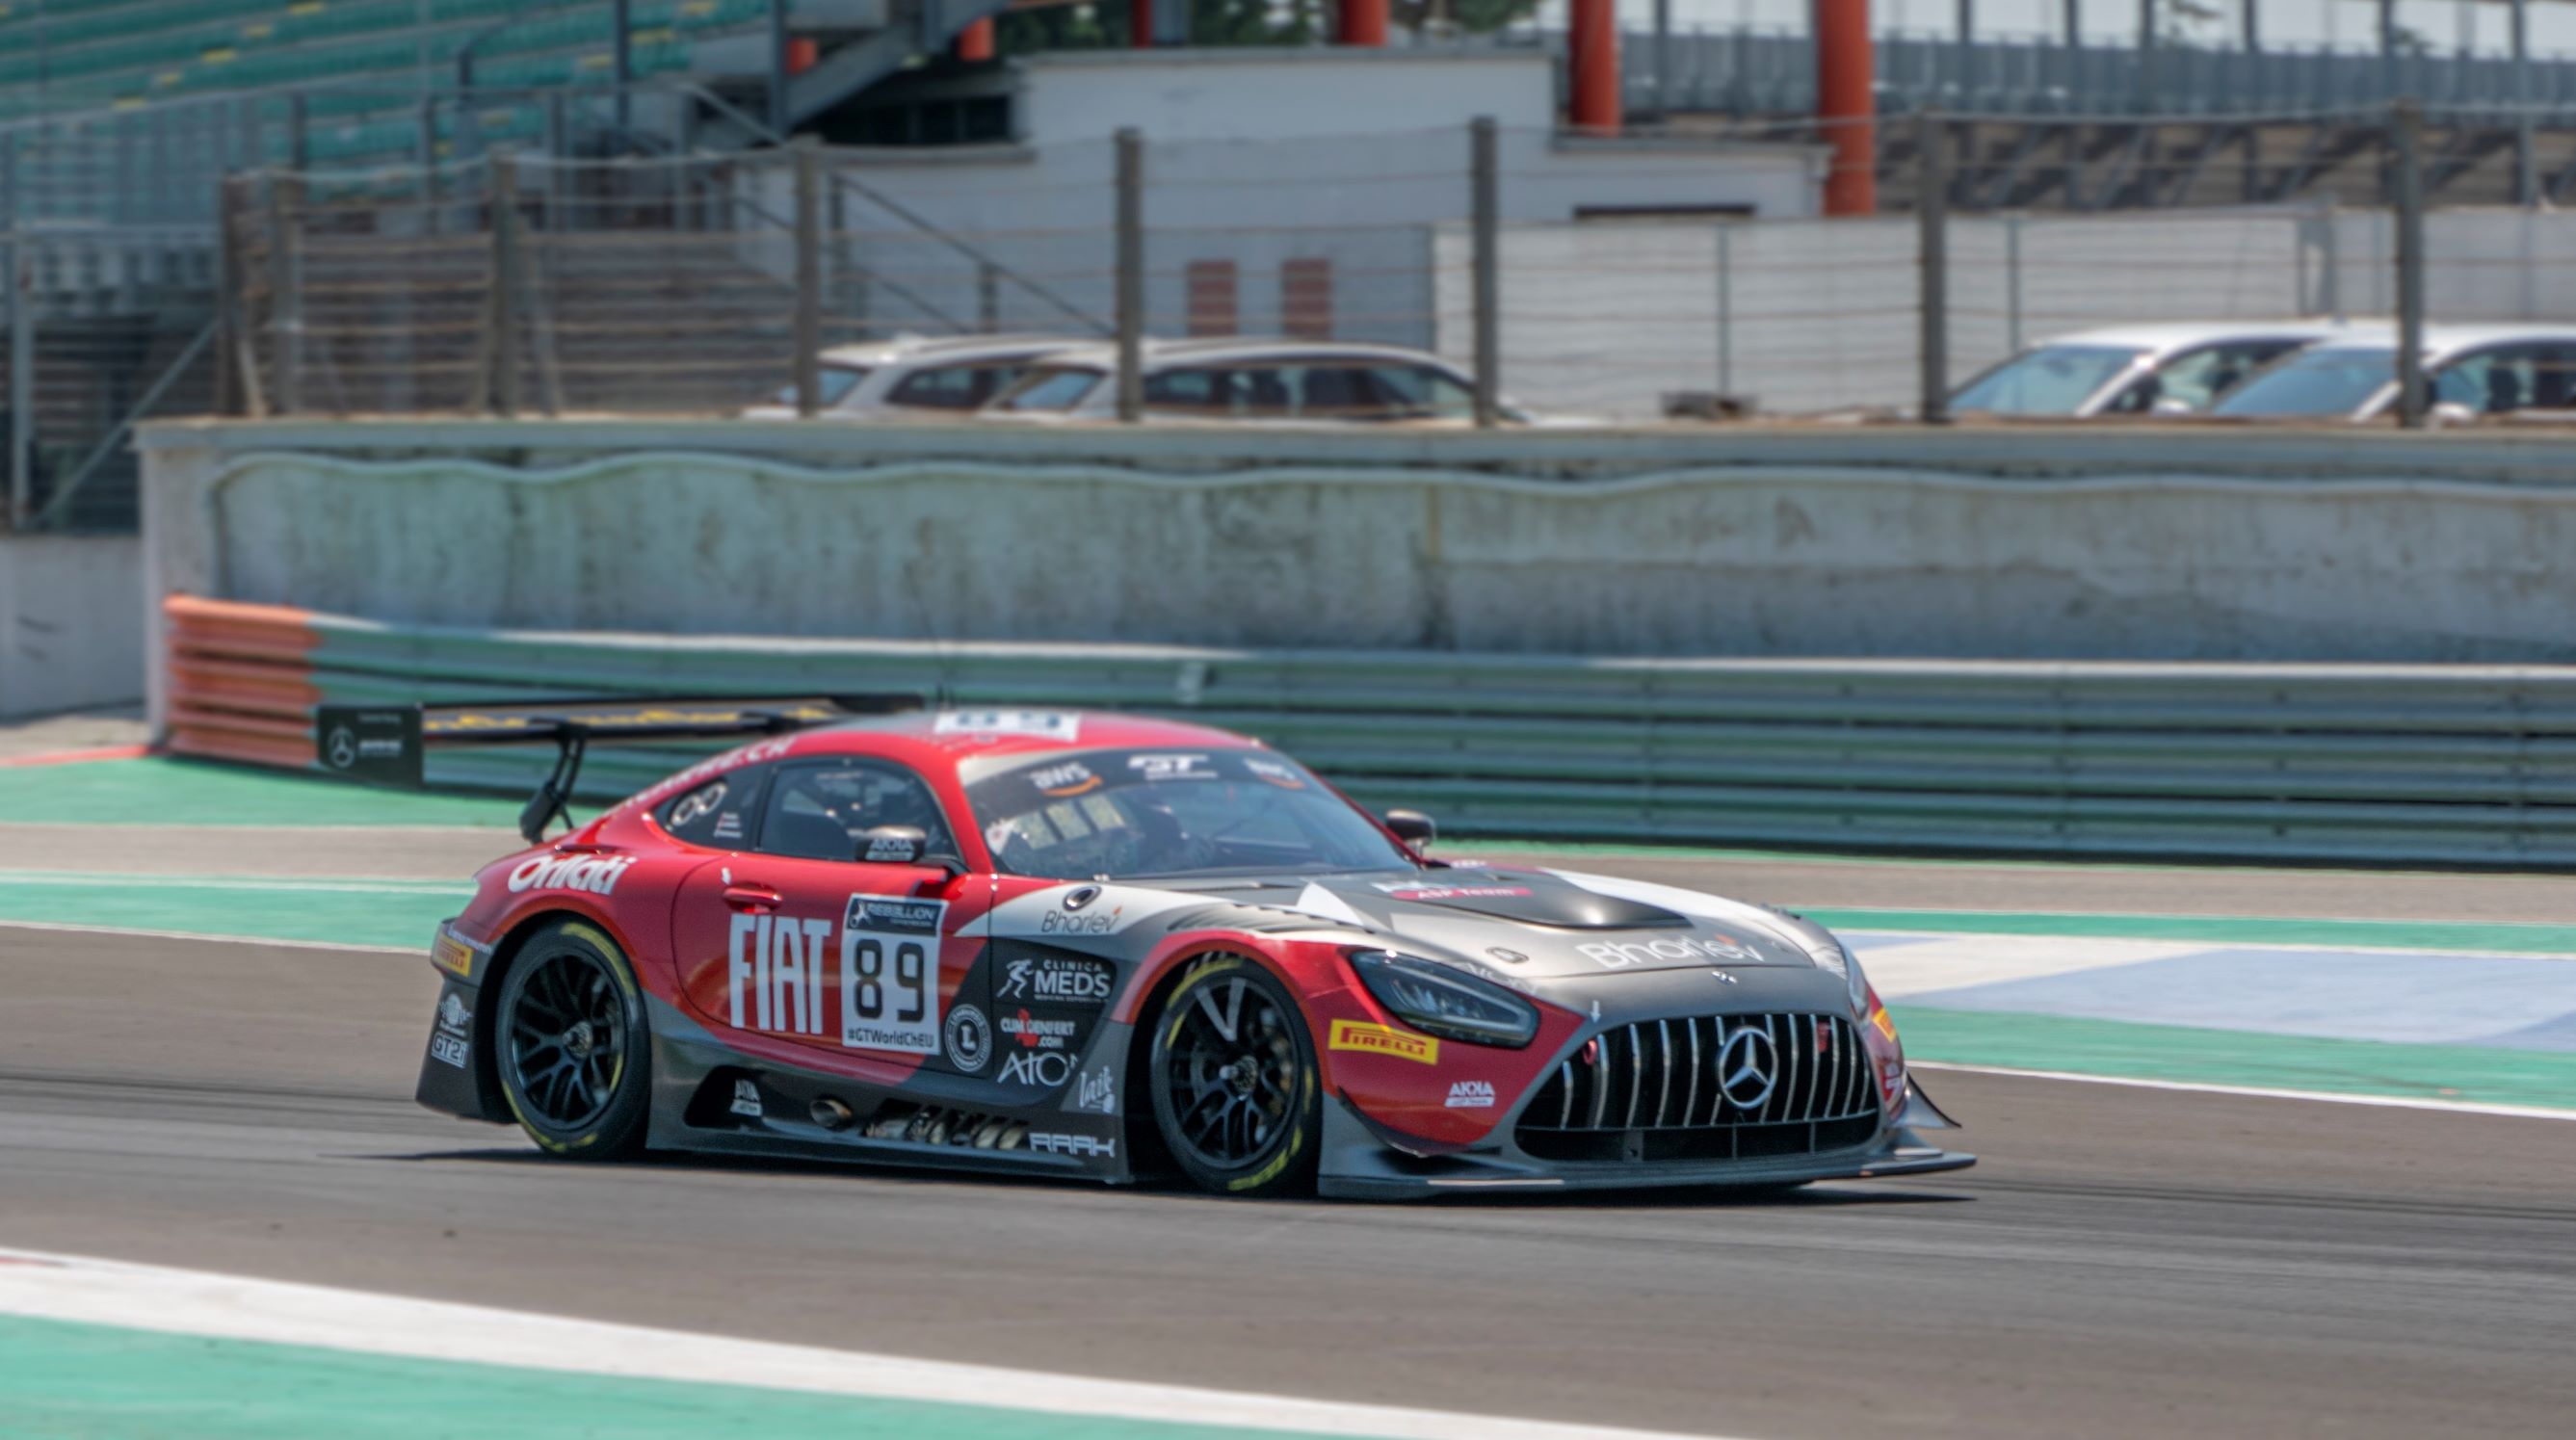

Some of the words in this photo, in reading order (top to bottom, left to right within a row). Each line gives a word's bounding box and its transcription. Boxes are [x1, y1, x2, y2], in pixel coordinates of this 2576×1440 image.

[867, 903, 935, 919] REBELLION
[1041, 909, 1121, 934] Bharlev
[728, 912, 832, 1035] FIAT
[1043, 958, 1103, 973] CLINICA
[854, 939, 925, 1024] 89
[1034, 969, 1112, 998] MEDS
[848, 1028, 934, 1048] #GTWorldChEU
[1340, 1026, 1428, 1057] PIRELLI
[1449, 1081, 1495, 1097] AKKA
